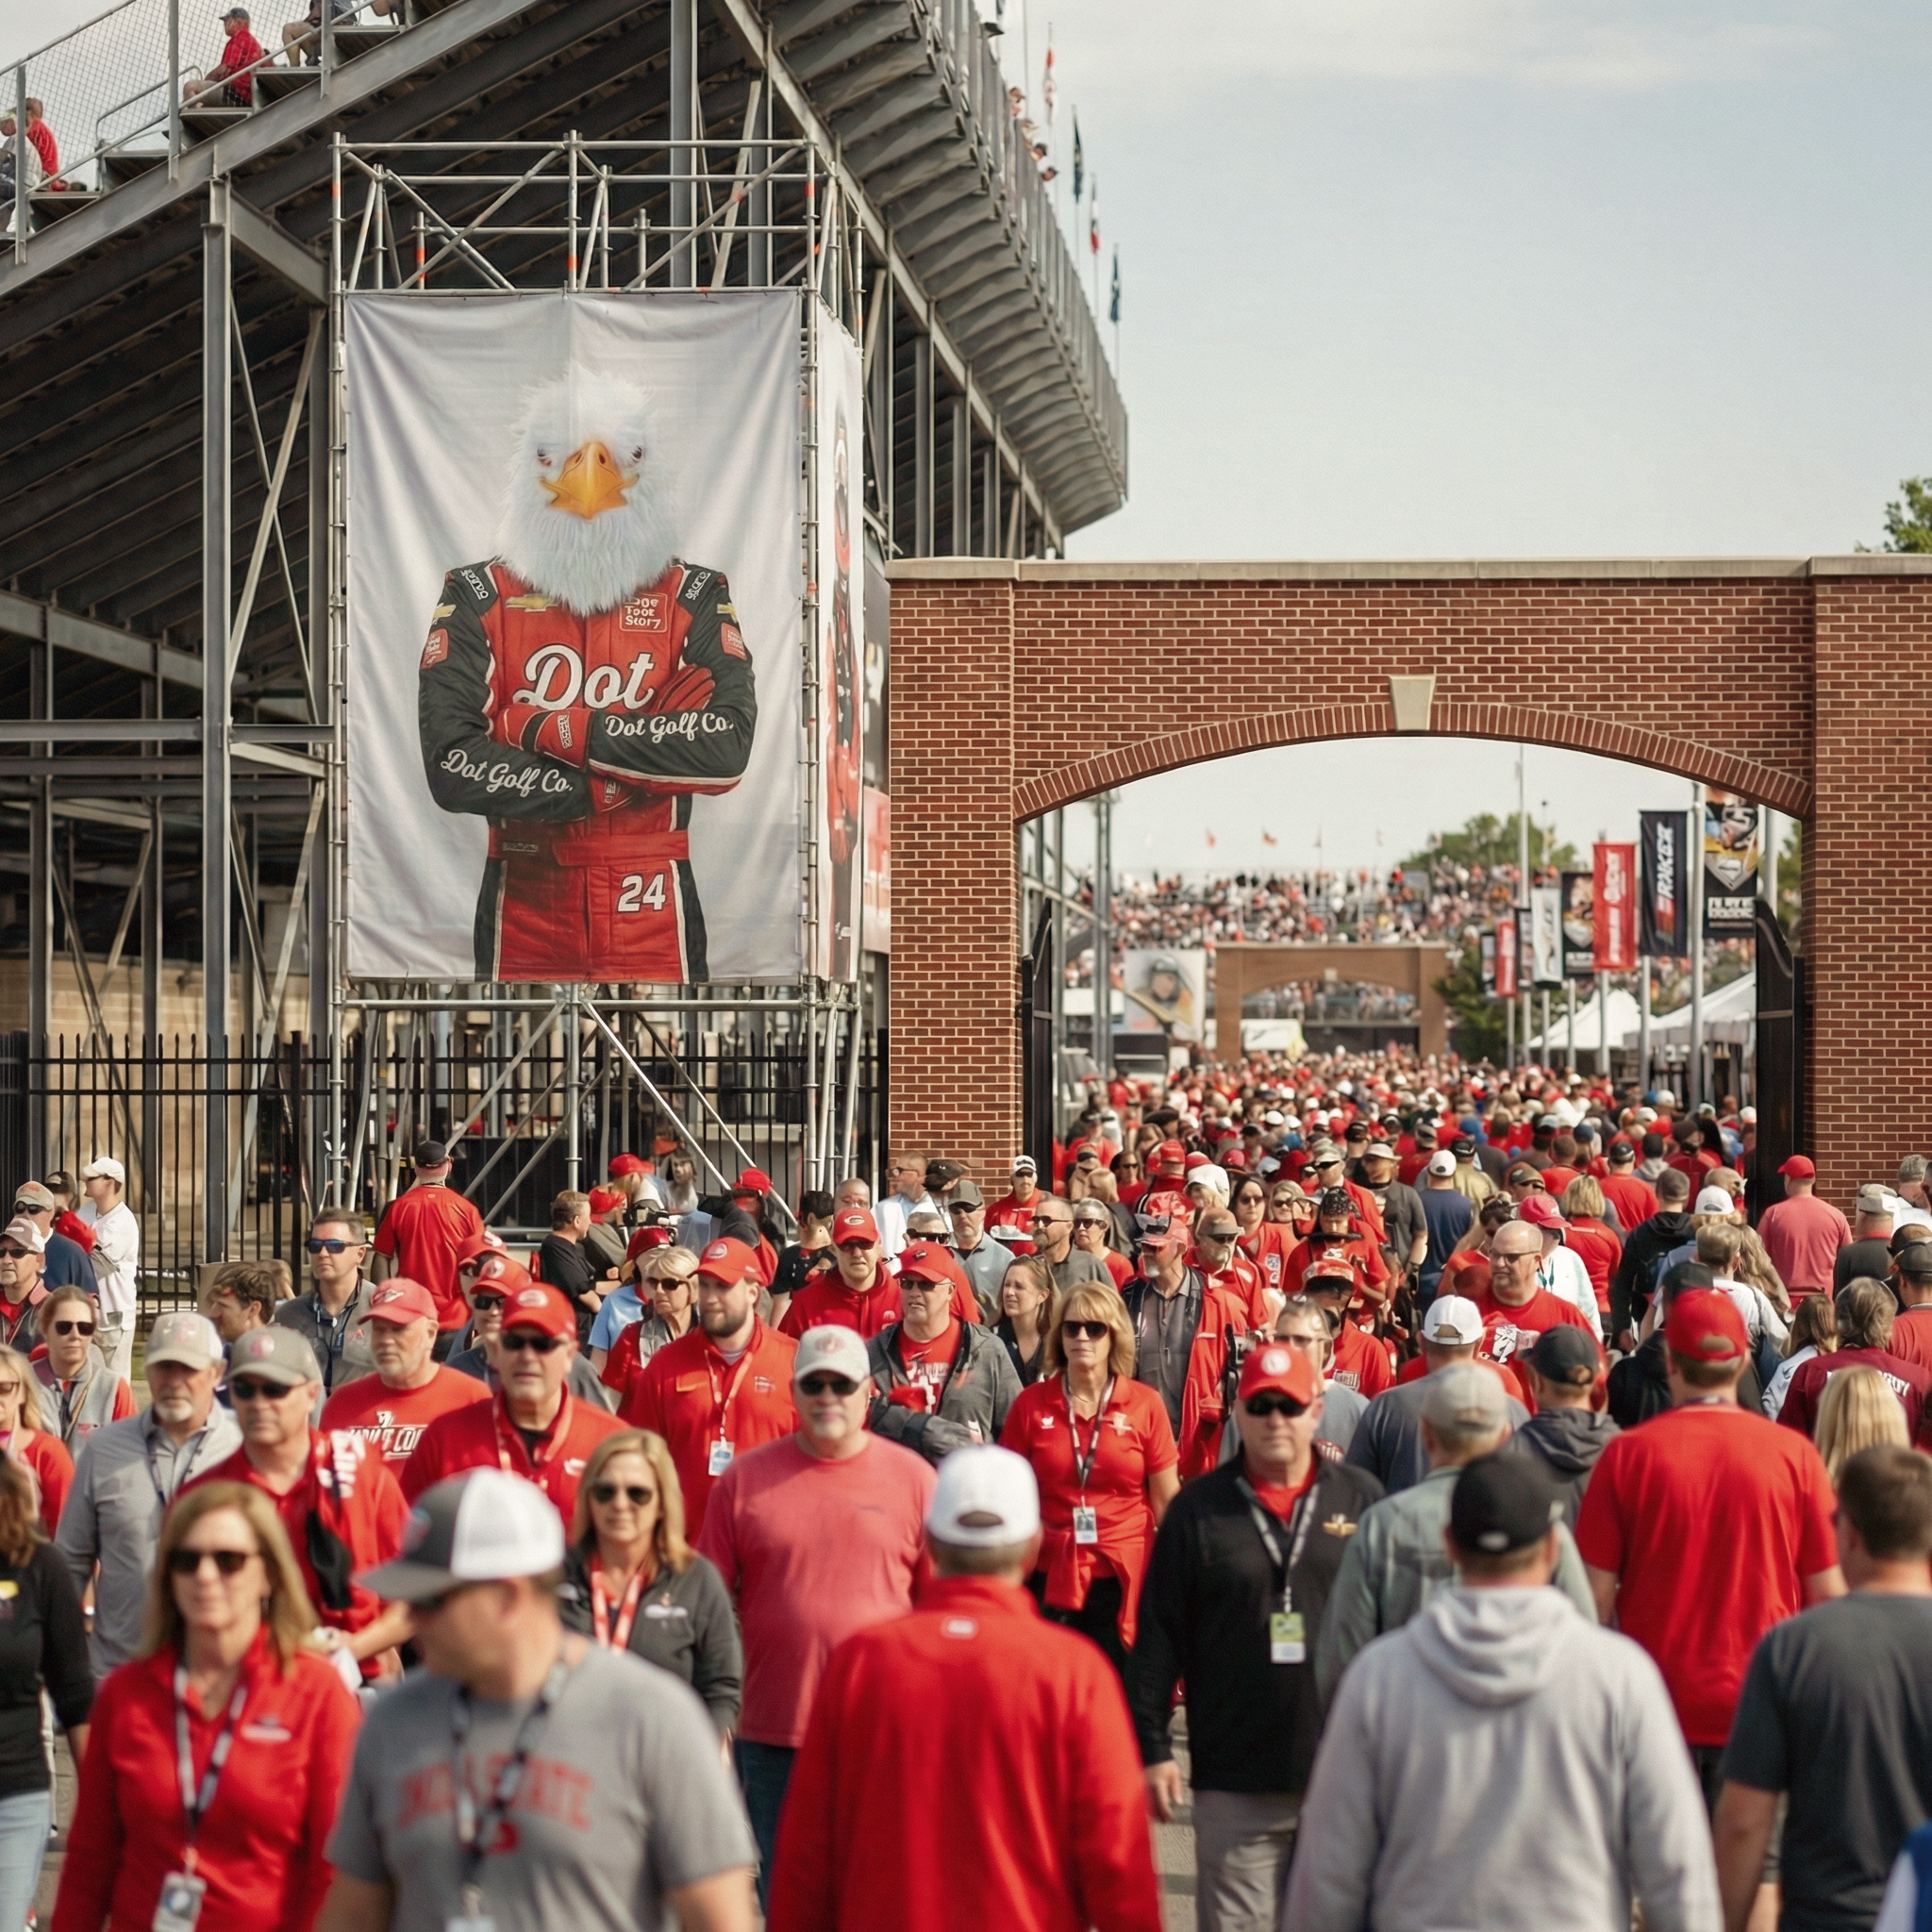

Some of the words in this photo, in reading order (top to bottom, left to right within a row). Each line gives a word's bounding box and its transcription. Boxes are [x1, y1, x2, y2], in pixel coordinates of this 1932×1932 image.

[512, 644, 655, 710] Dot
[605, 715, 646, 737] Dot
[649, 711, 699, 743] Golf
[701, 712, 734, 733] Co.
[440, 748, 488, 781] Dot
[486, 762, 541, 798] Golf
[541, 768, 574, 792] Co.
[617, 873, 667, 912] 24
